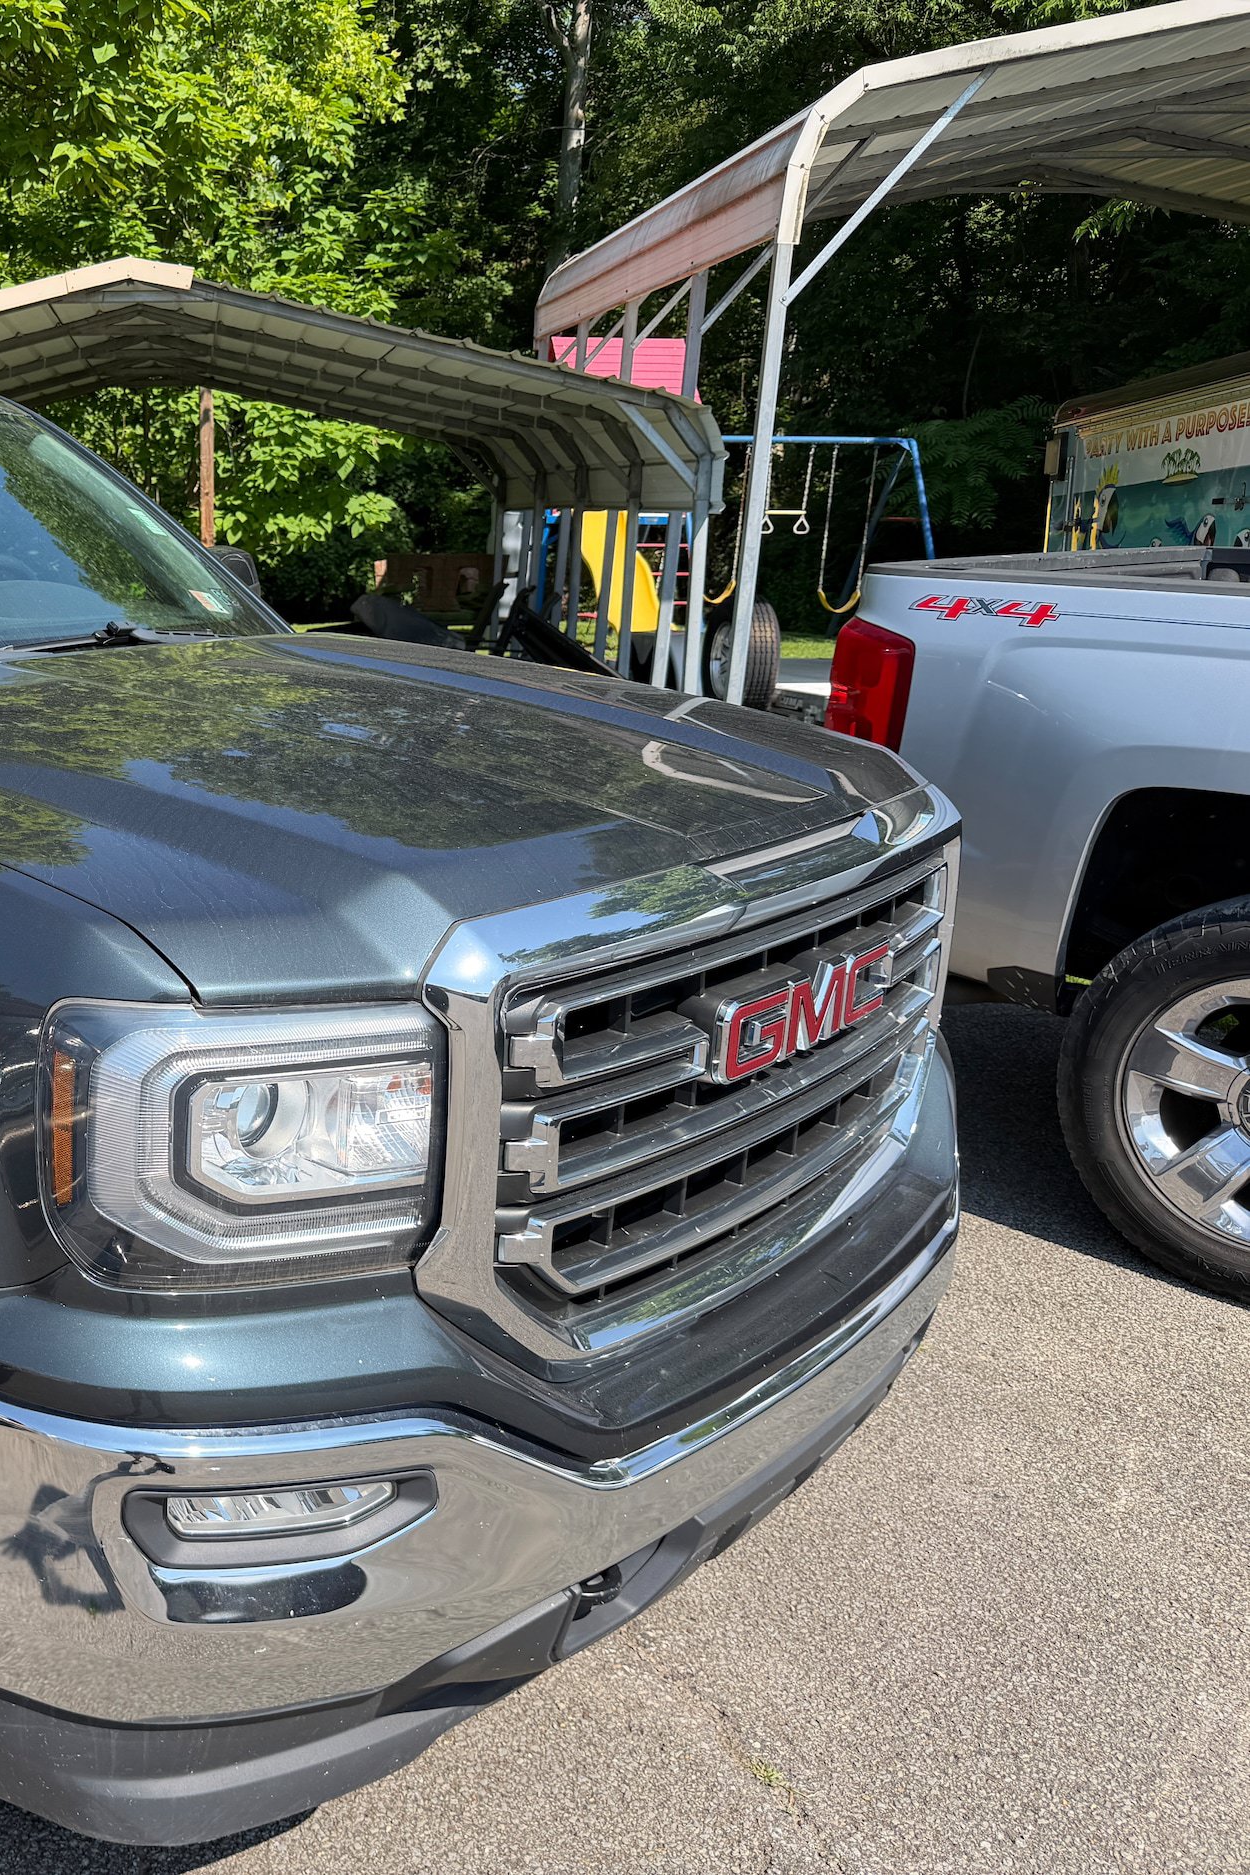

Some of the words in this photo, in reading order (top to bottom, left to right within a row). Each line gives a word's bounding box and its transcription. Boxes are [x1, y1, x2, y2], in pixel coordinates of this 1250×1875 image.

[1085, 431, 1123, 458] PARTY
[1126, 422, 1160, 452] WITH
[1161, 420, 1172, 444] A
[713, 936, 892, 1086] GMC
